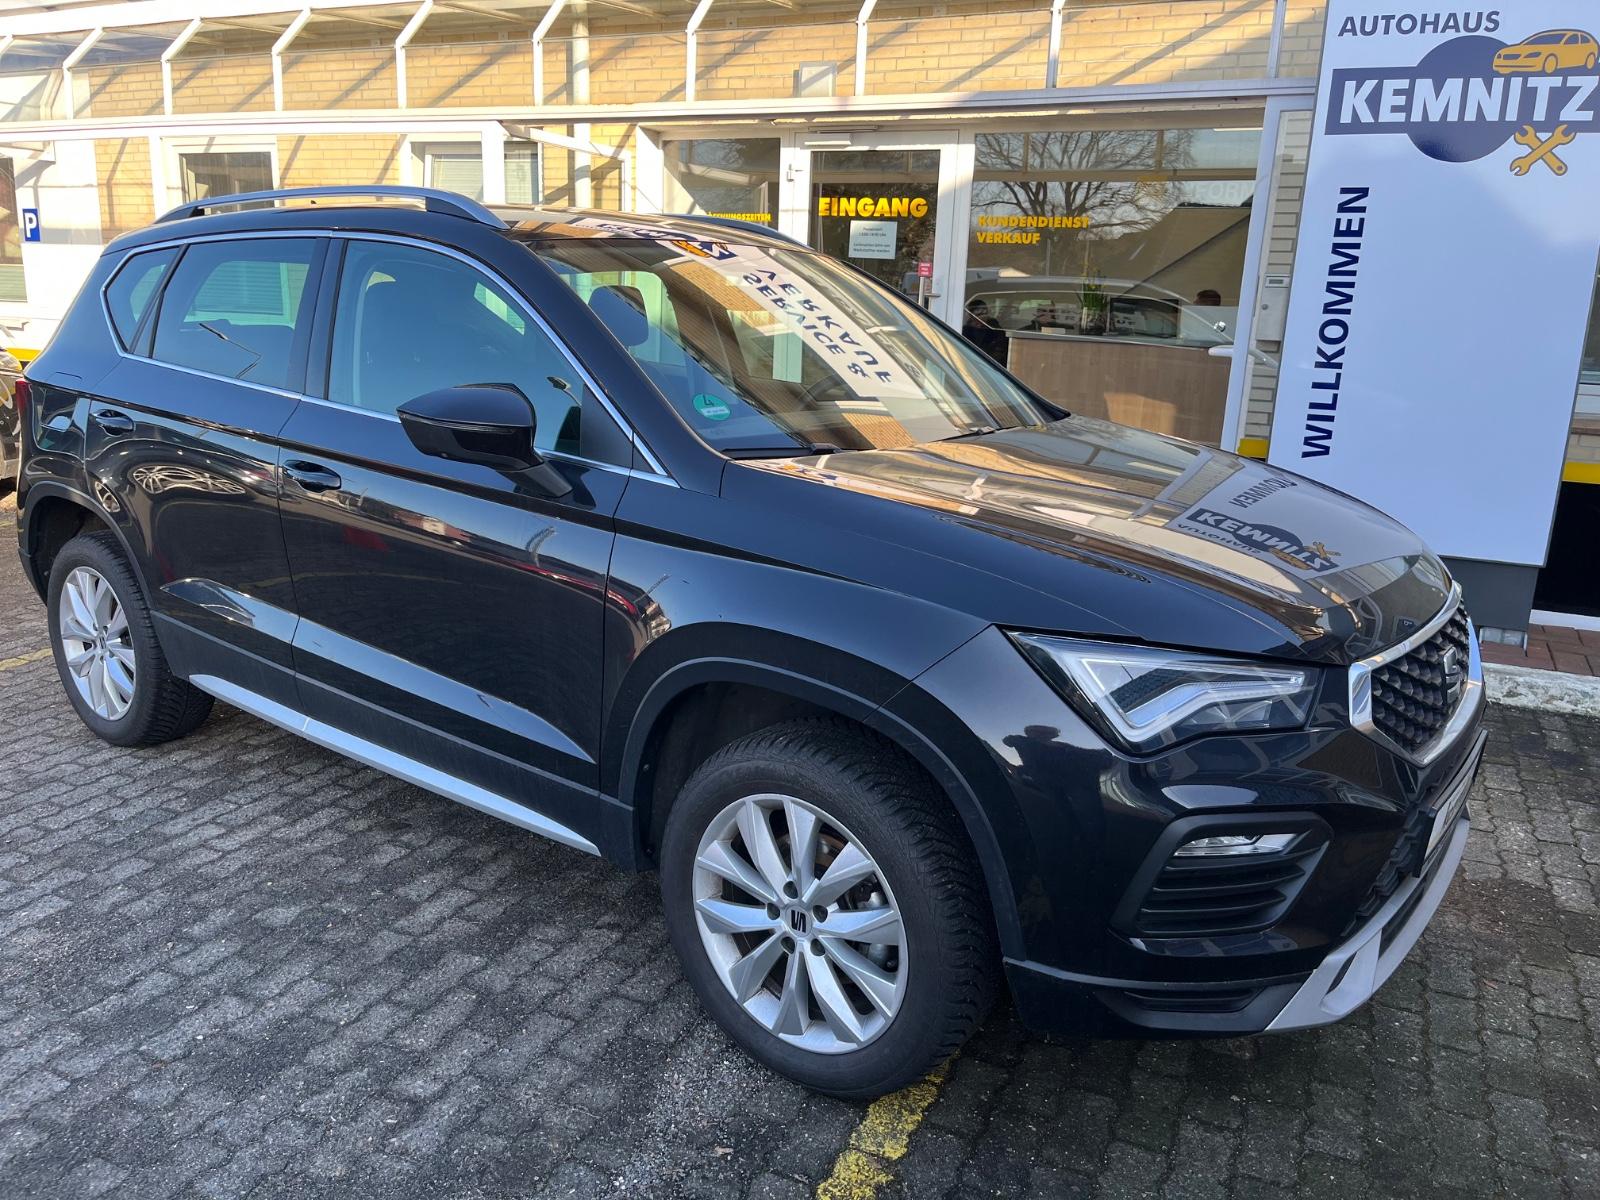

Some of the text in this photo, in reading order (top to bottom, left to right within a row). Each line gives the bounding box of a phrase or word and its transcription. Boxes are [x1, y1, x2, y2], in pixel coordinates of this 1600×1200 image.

[1338, 10, 1500, 37] AUTOHAUS
[1339, 76, 1598, 124] KEMNITZ
[818, 197, 929, 218] EINGANG
[24, 212, 38, 239] P
[977, 215, 1090, 229] KUNDENDIENST
[976, 231, 1041, 245] VERKAUF
[1301, 186, 1370, 459] WILLKOMMEN
